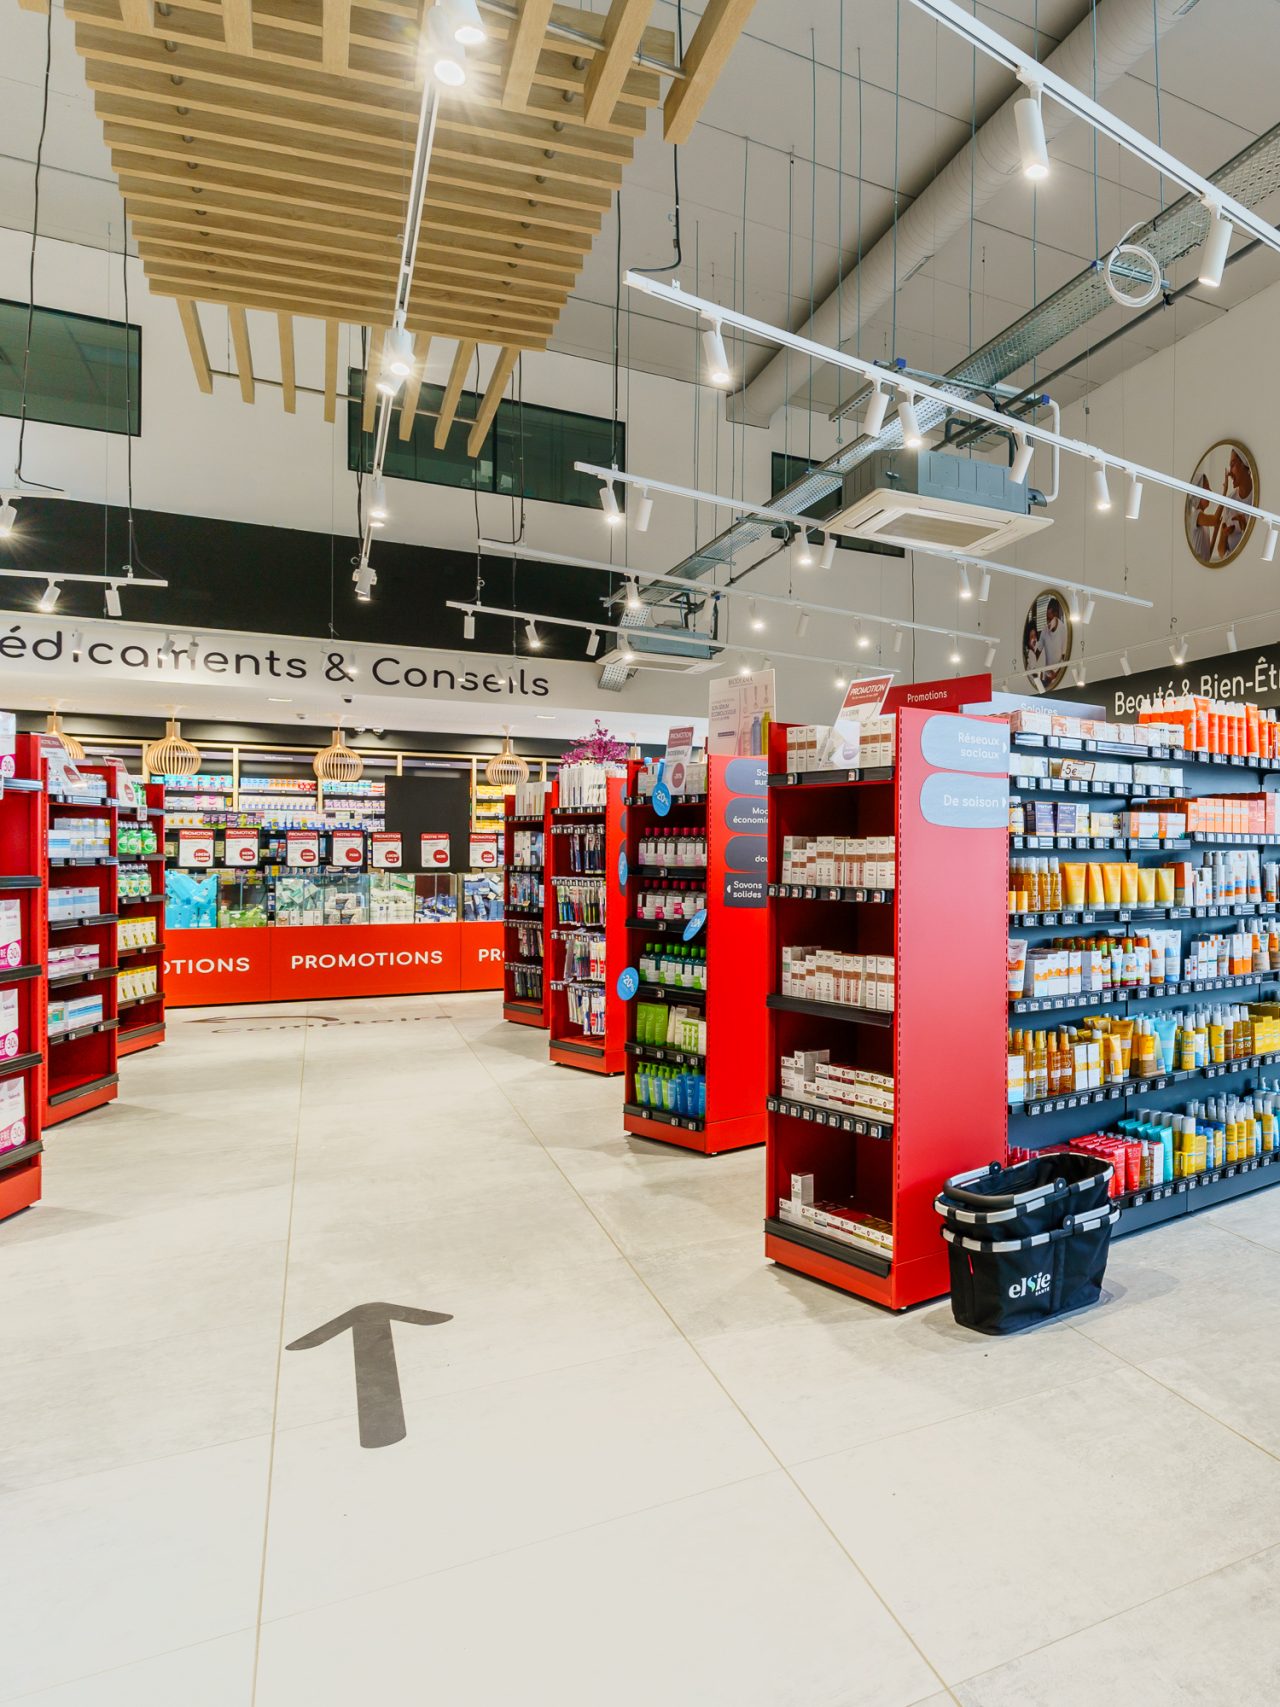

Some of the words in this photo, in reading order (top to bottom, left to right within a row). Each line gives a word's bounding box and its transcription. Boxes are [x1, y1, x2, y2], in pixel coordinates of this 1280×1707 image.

[325, 652, 354, 682] &
[372, 657, 549, 696] Conseils
[850, 684, 886, 696] PROMOTION
[907, 691, 948, 702] Promotions
[958, 732, 1000, 746] Réseaux
[960, 748, 999, 759] sociaux
[756, 769, 768, 777] Sa
[755, 779, 768, 787] sur
[944, 794, 959, 806] De
[962, 796, 999, 807] saison
[755, 855, 768, 863] dou
[733, 881, 762, 890] Savons
[733, 890, 762, 899] solides
[292, 950, 443, 969] PROMOTIONS
[478, 949, 504, 962] PR
[622, 975, 635, 993] -20%
